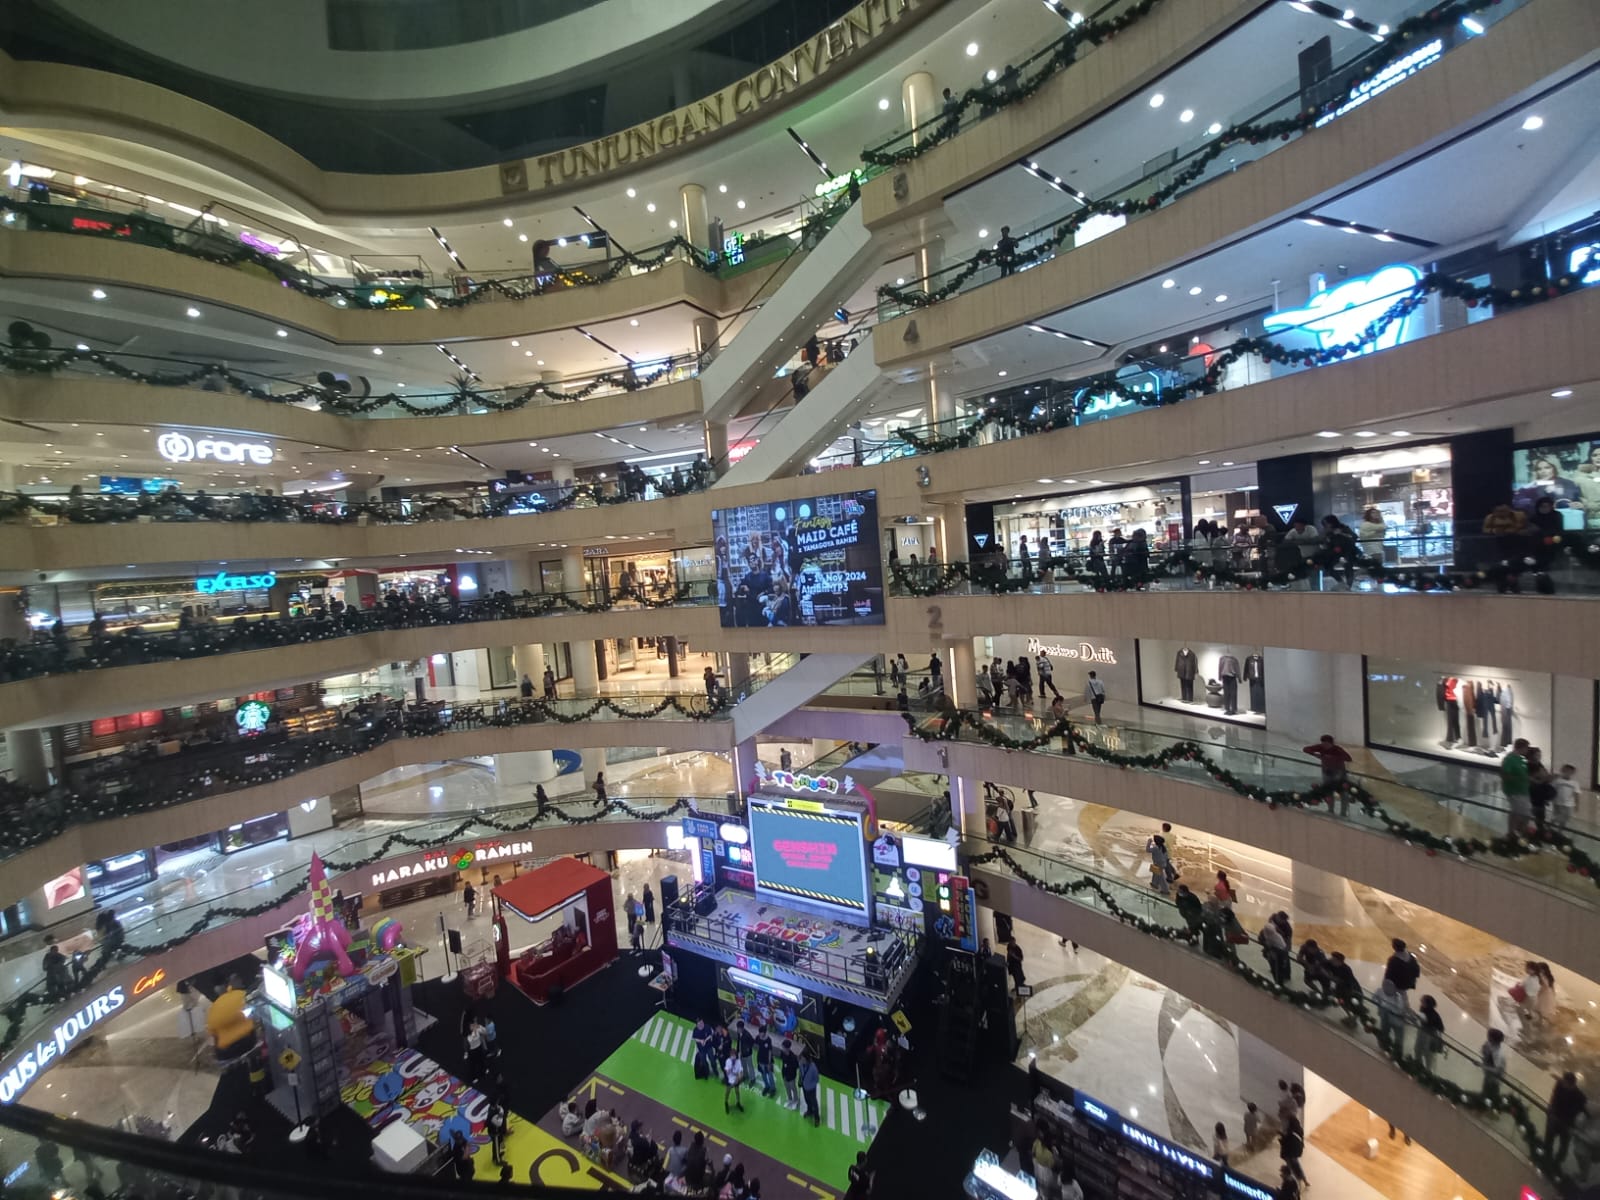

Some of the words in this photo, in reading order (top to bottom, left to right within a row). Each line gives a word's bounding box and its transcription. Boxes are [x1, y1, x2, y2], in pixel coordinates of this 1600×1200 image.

[537, 92, 724, 185] TUNJUNGAN
[916, 465, 931, 488] 3
[797, 529, 827, 545] MAID
[830, 519, 859, 538] CAFÉ
[196, 572, 276, 593] EXCELSO
[845, 571, 867, 581] 2024
[927, 605, 943, 629] 2
[372, 856, 448, 886] HARAKU
[475, 841, 533, 862] RAMEN
[54, 985, 125, 1055] JOURS
